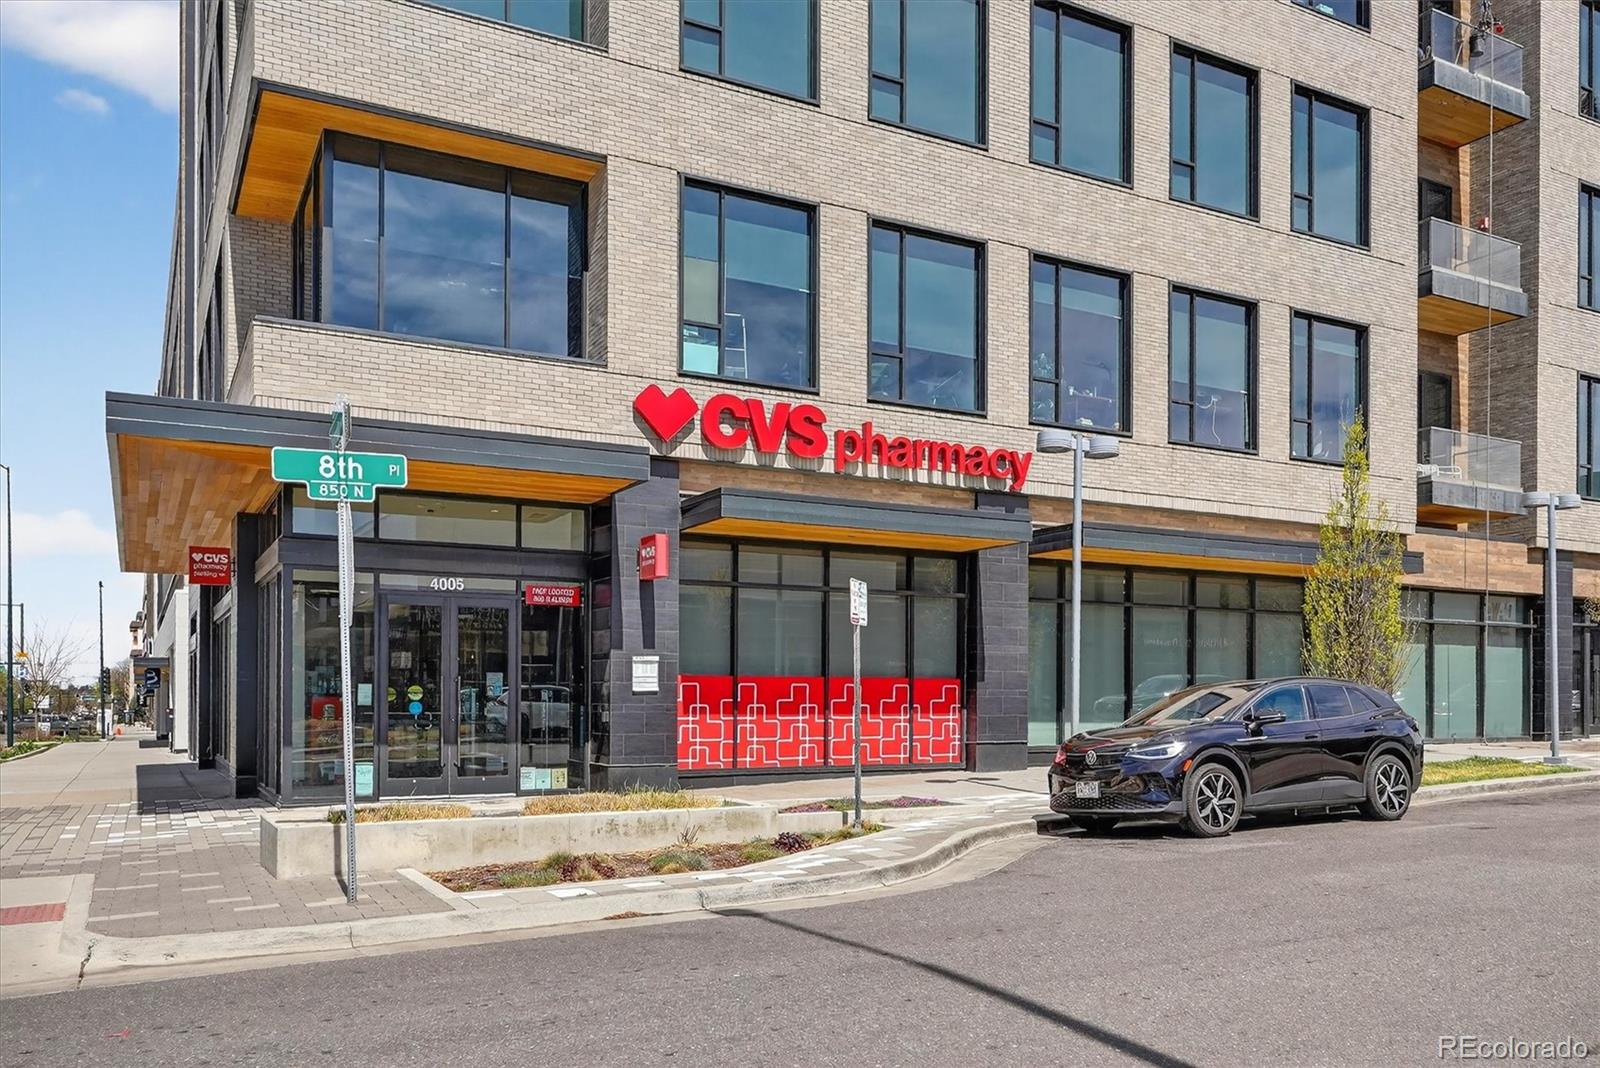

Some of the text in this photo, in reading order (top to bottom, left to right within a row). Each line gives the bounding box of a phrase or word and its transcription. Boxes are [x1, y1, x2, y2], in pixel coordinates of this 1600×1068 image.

[701, 393, 1033, 491] CVS pharmacy
[319, 455, 400, 479] 8th Pl
[320, 484, 364, 498] 850 N
[203, 553, 229, 563] CVS
[430, 578, 465, 591] 4005
